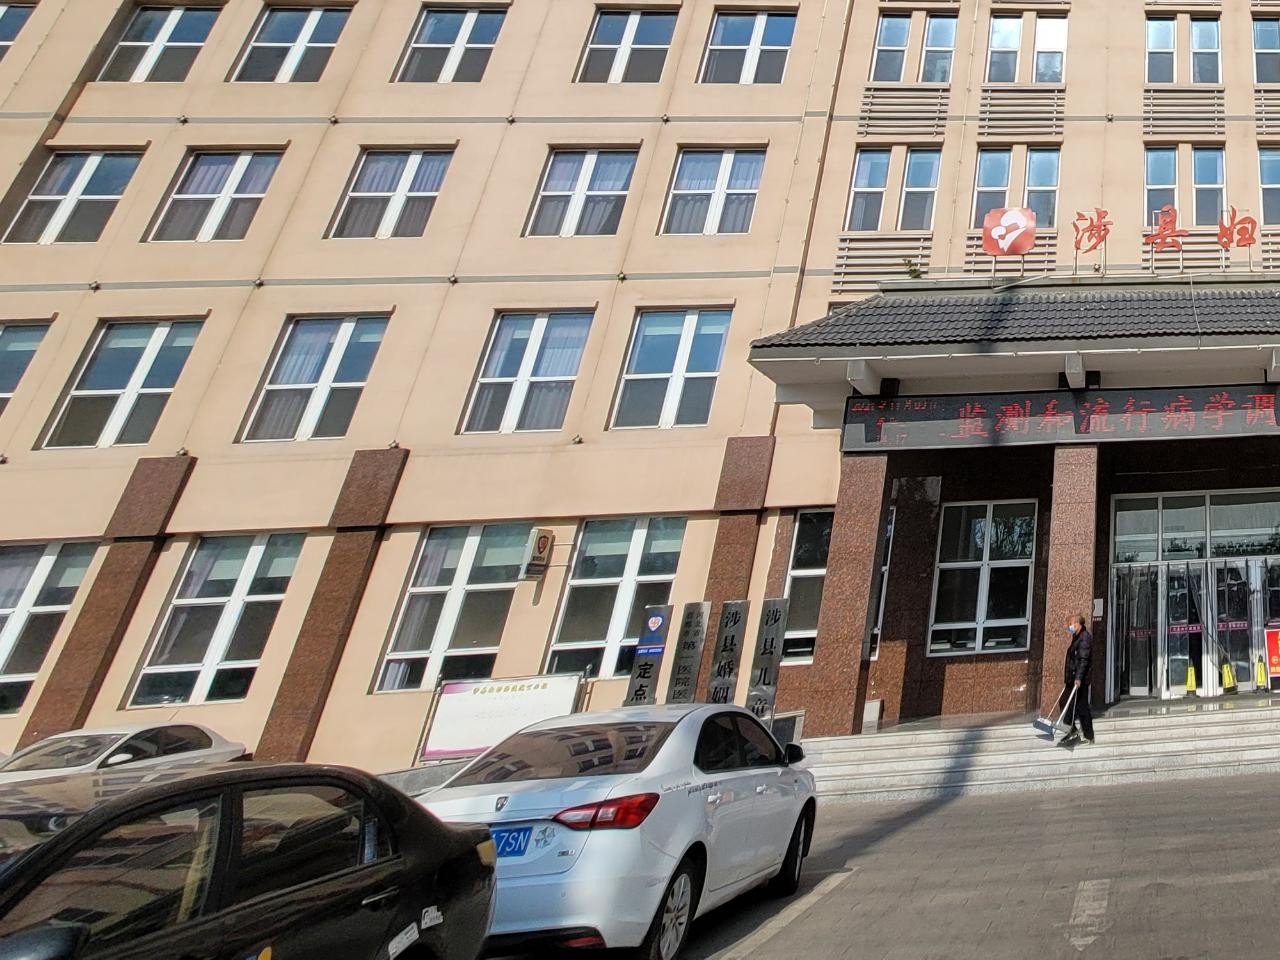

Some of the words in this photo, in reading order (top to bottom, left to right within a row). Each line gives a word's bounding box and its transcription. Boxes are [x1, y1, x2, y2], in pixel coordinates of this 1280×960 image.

[711, 610, 741, 704] 涉县婚姻
[630, 661, 654, 702] 定点
[492, 830, 530, 854] 7SN
